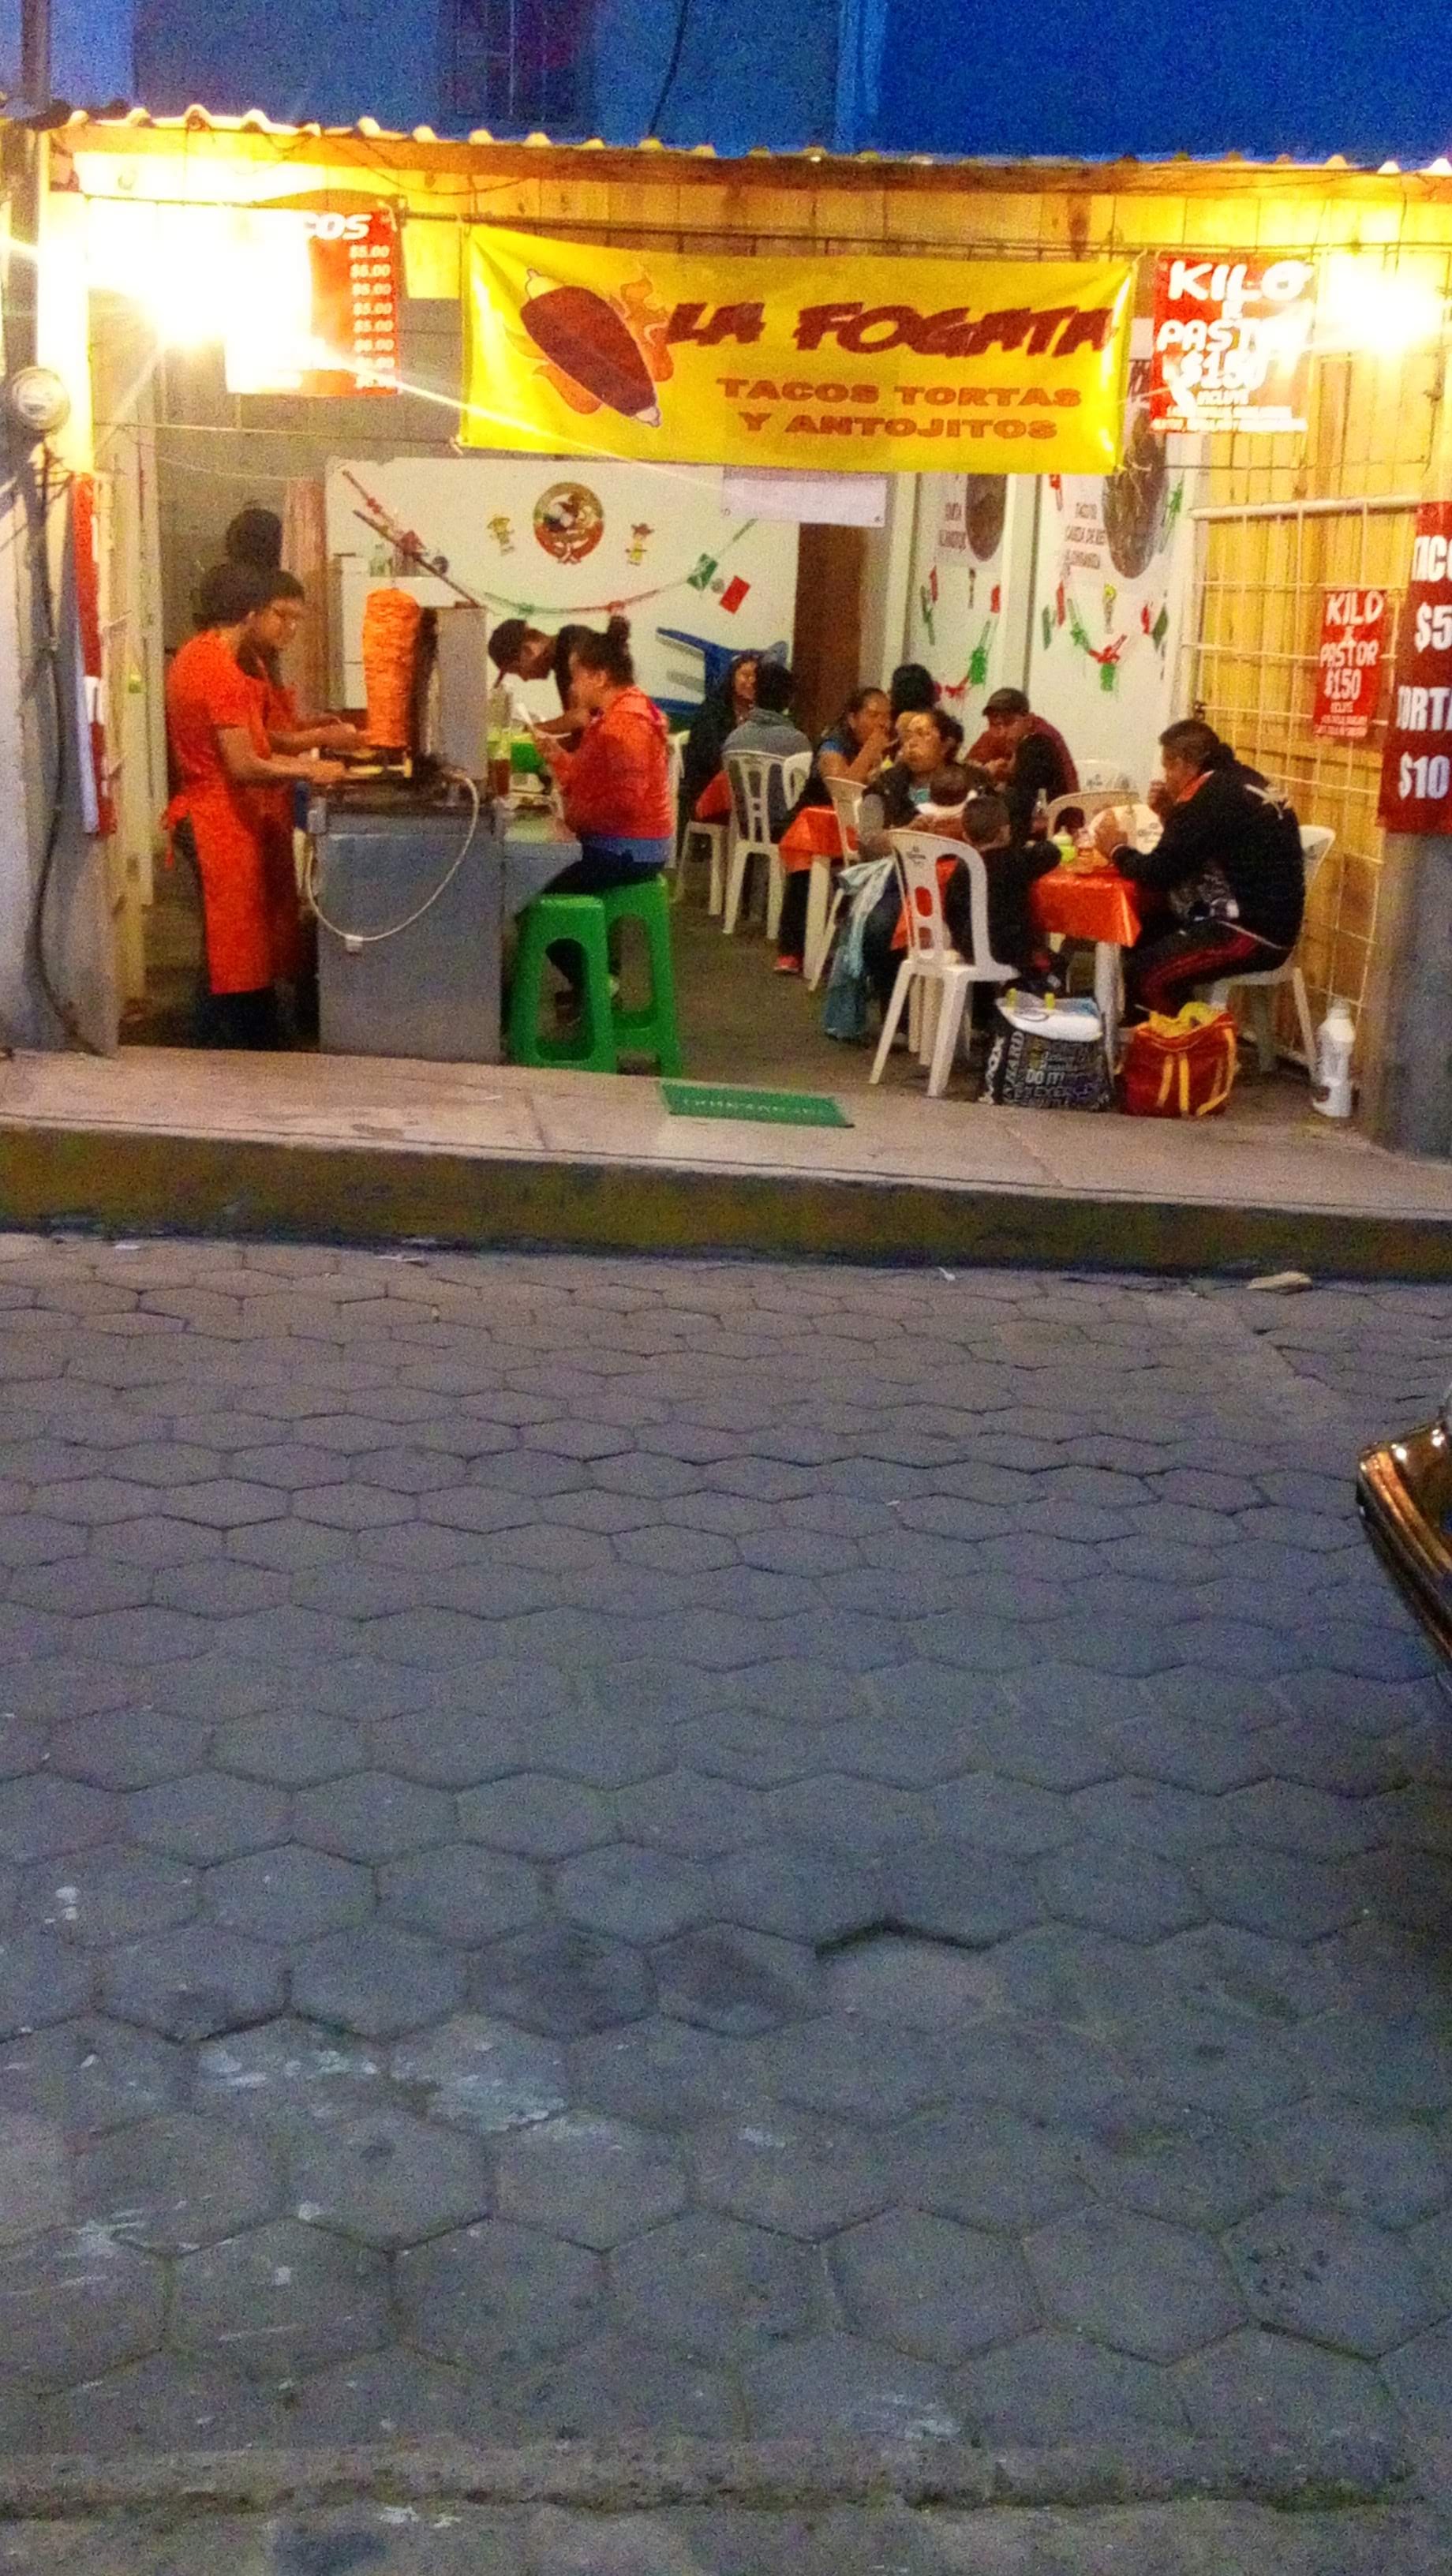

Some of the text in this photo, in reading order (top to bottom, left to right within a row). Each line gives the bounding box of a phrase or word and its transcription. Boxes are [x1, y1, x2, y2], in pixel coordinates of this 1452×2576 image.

[1168, 260, 1310, 301] KILO
[666, 301, 1115, 358] LA FOGATA
[716, 377, 1083, 408] TACOS TORTAS
[738, 412, 1058, 440] Y ANTOJITOS
[1326, 590, 1385, 627] KILO
[1319, 640, 1380, 668] PASTOR
[1323, 668, 1363, 702] $150
[1398, 751, 1451, 800] $10
